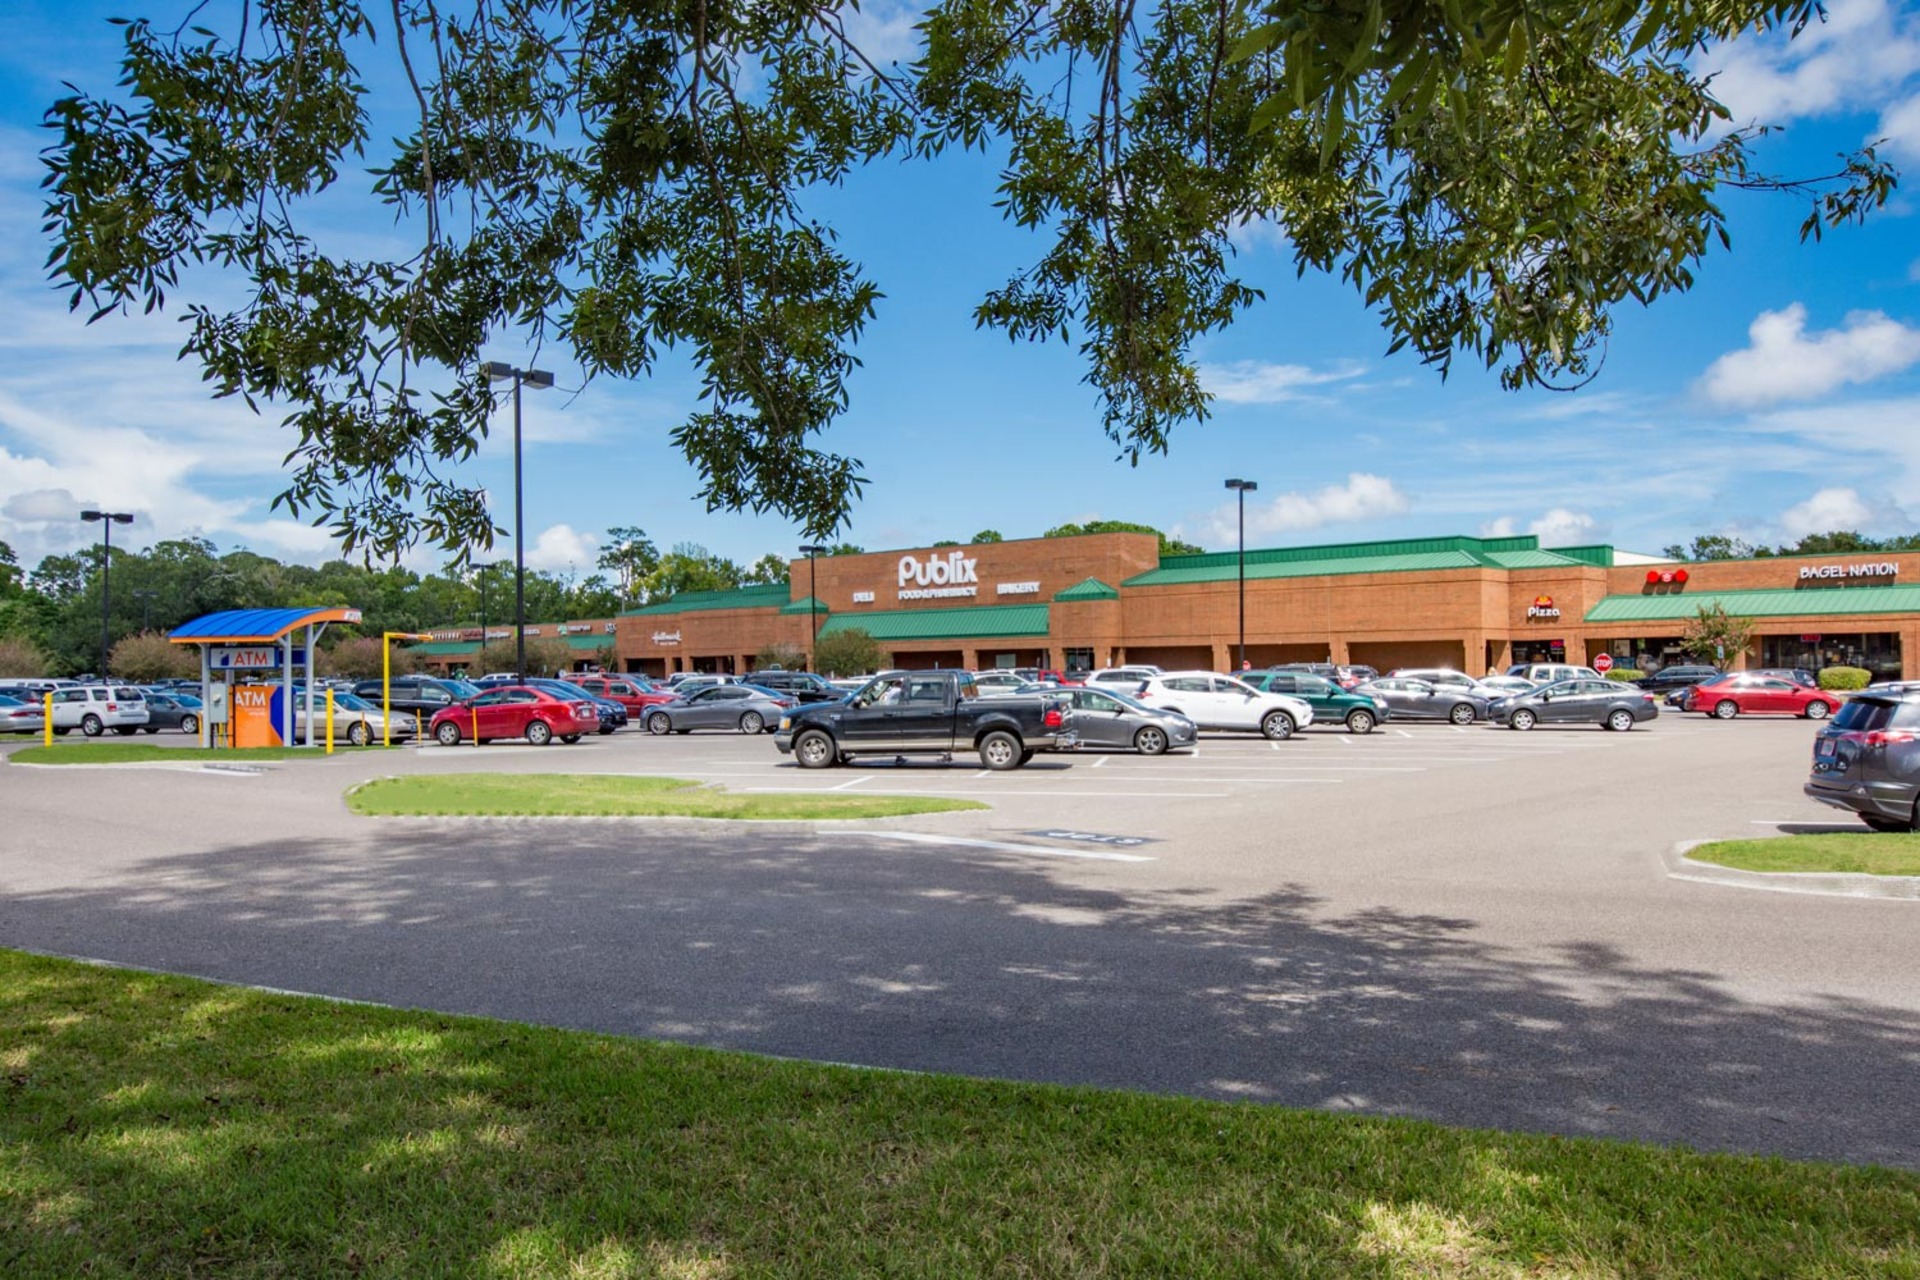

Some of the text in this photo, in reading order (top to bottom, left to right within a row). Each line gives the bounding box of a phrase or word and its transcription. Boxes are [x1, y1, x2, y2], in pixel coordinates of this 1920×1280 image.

[898, 551, 978, 587] Publix
[1800, 562, 1899, 579] BAGEL NATION
[997, 581, 1041, 595] BAKERY
[853, 591, 875, 603] DELI
[1527, 606, 1560, 617] Pizza
[234, 651, 268, 666] ATM
[1595, 659, 1611, 667] STOP
[235, 691, 266, 706] ATM
